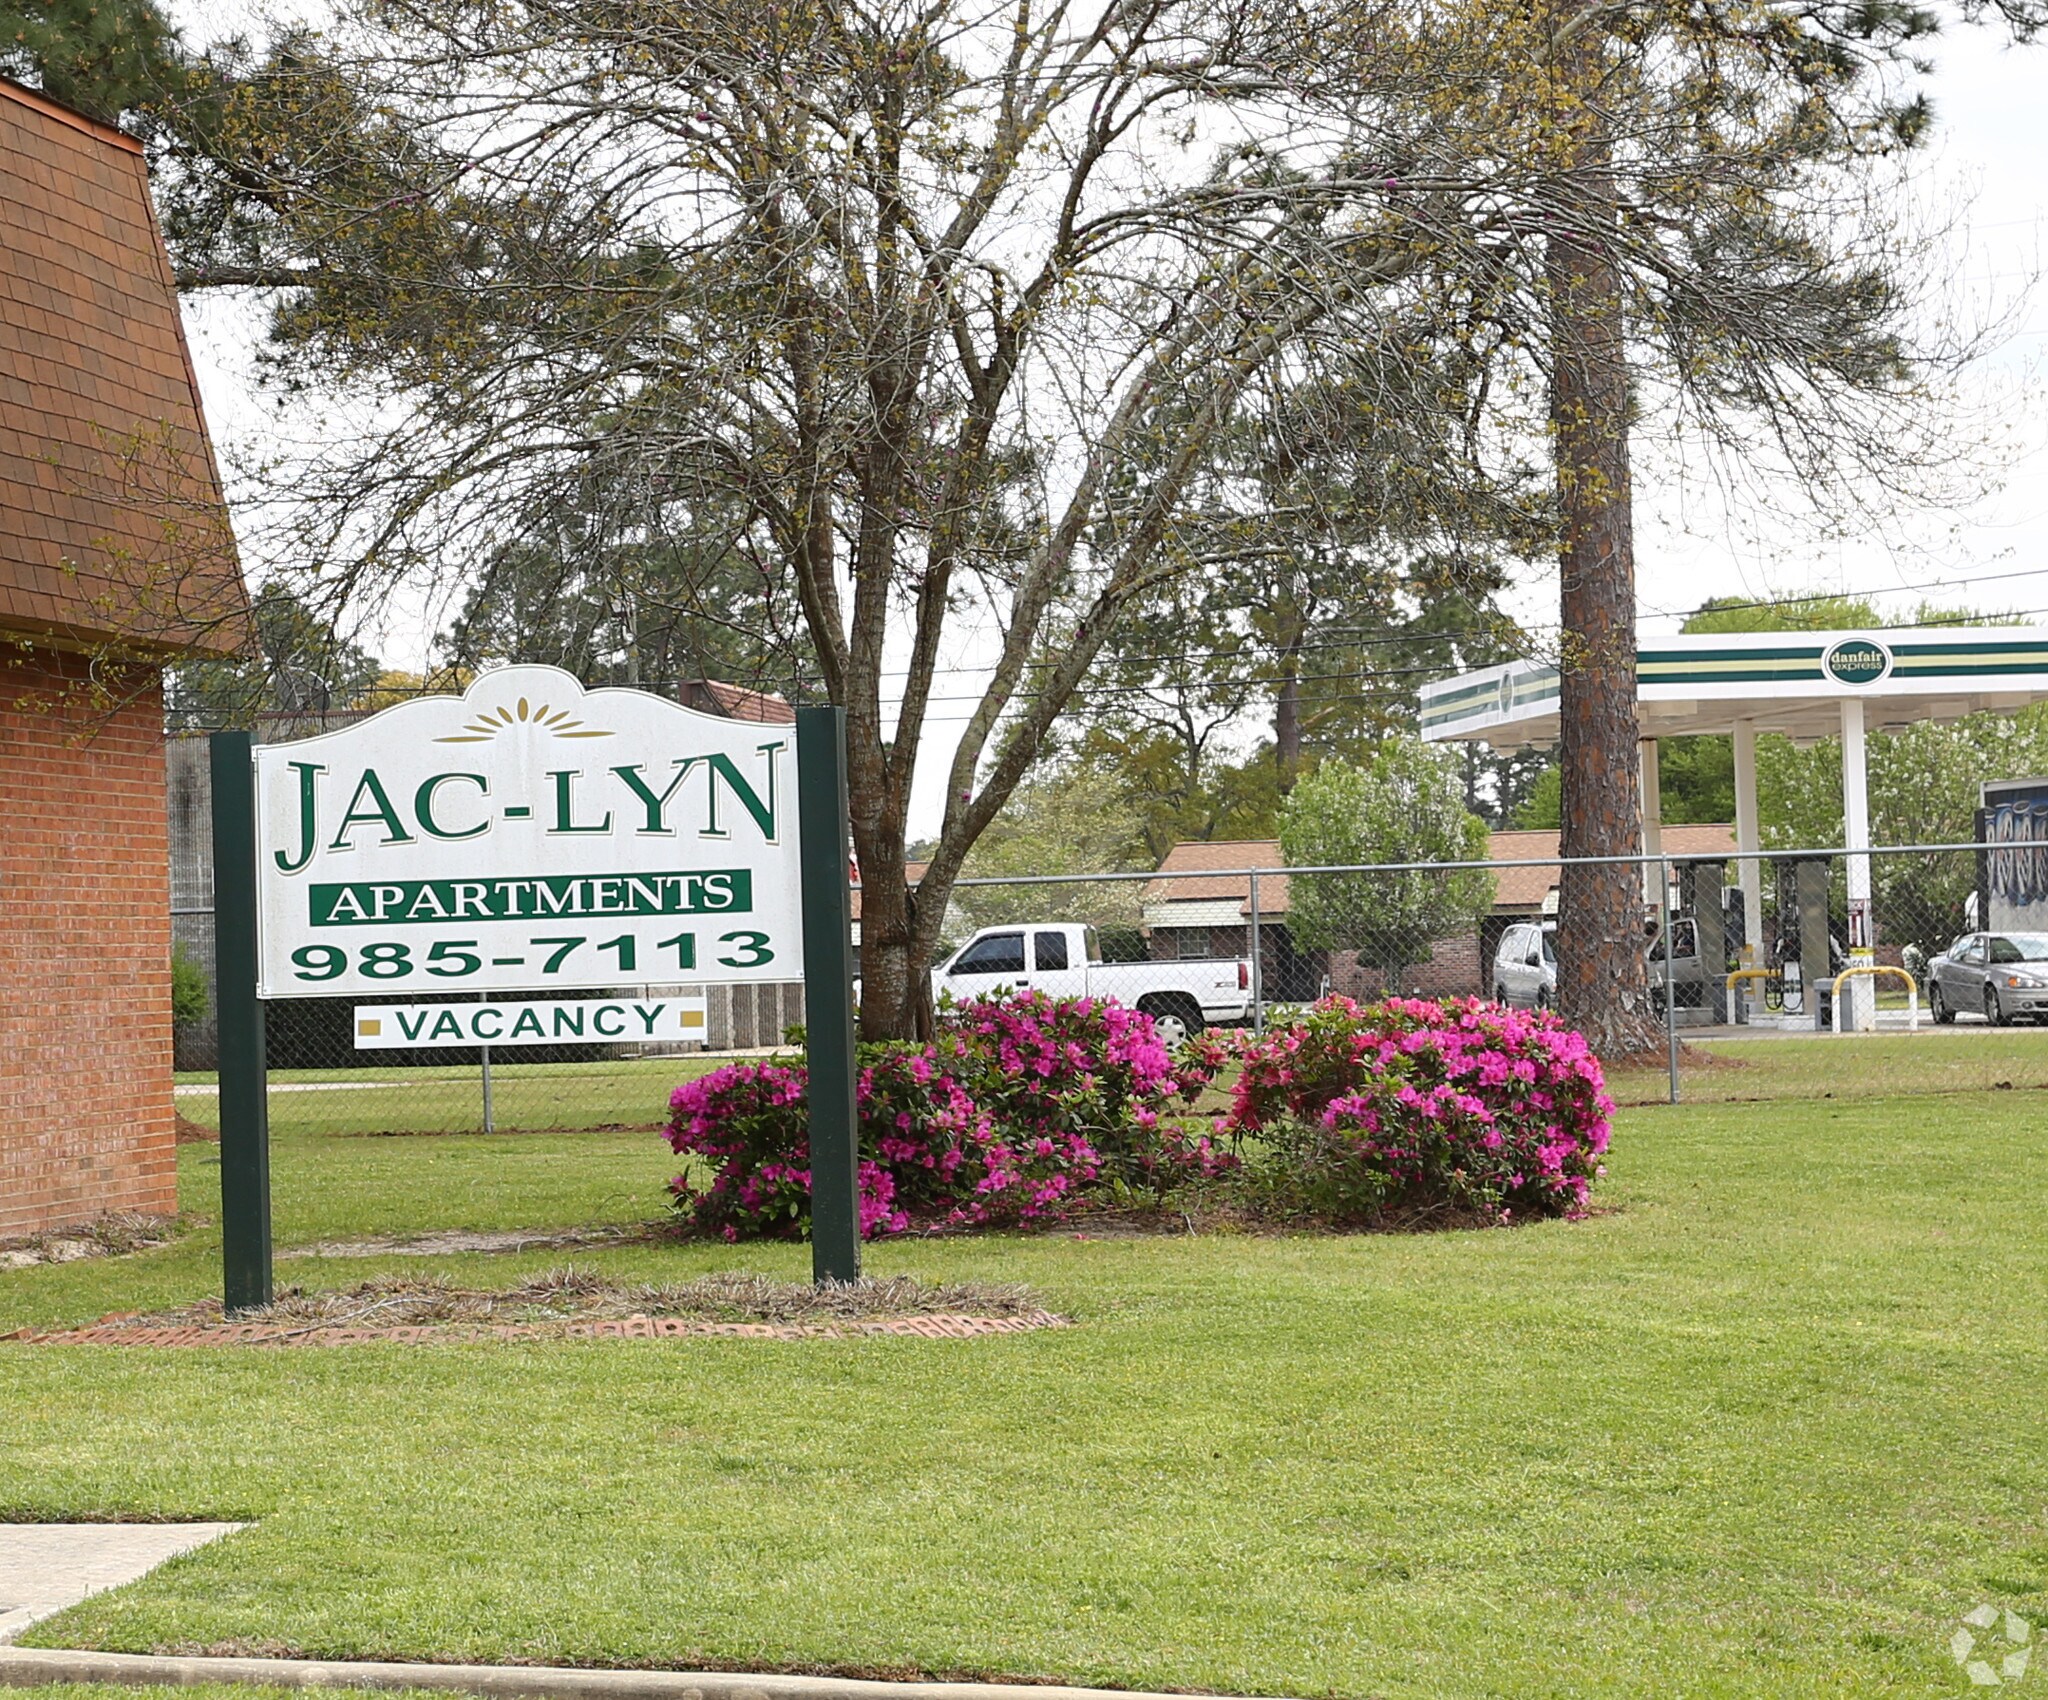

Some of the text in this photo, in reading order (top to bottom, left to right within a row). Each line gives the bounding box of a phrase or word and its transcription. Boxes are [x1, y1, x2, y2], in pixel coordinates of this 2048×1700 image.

[1831, 650, 1883, 662] danfair
[1832, 661, 1883, 672] express
[275, 741, 785, 872] JAC-LYN
[326, 874, 734, 921] APARTMENTS
[291, 930, 775, 981] 985-7113
[396, 1004, 667, 1041] VACANCY
